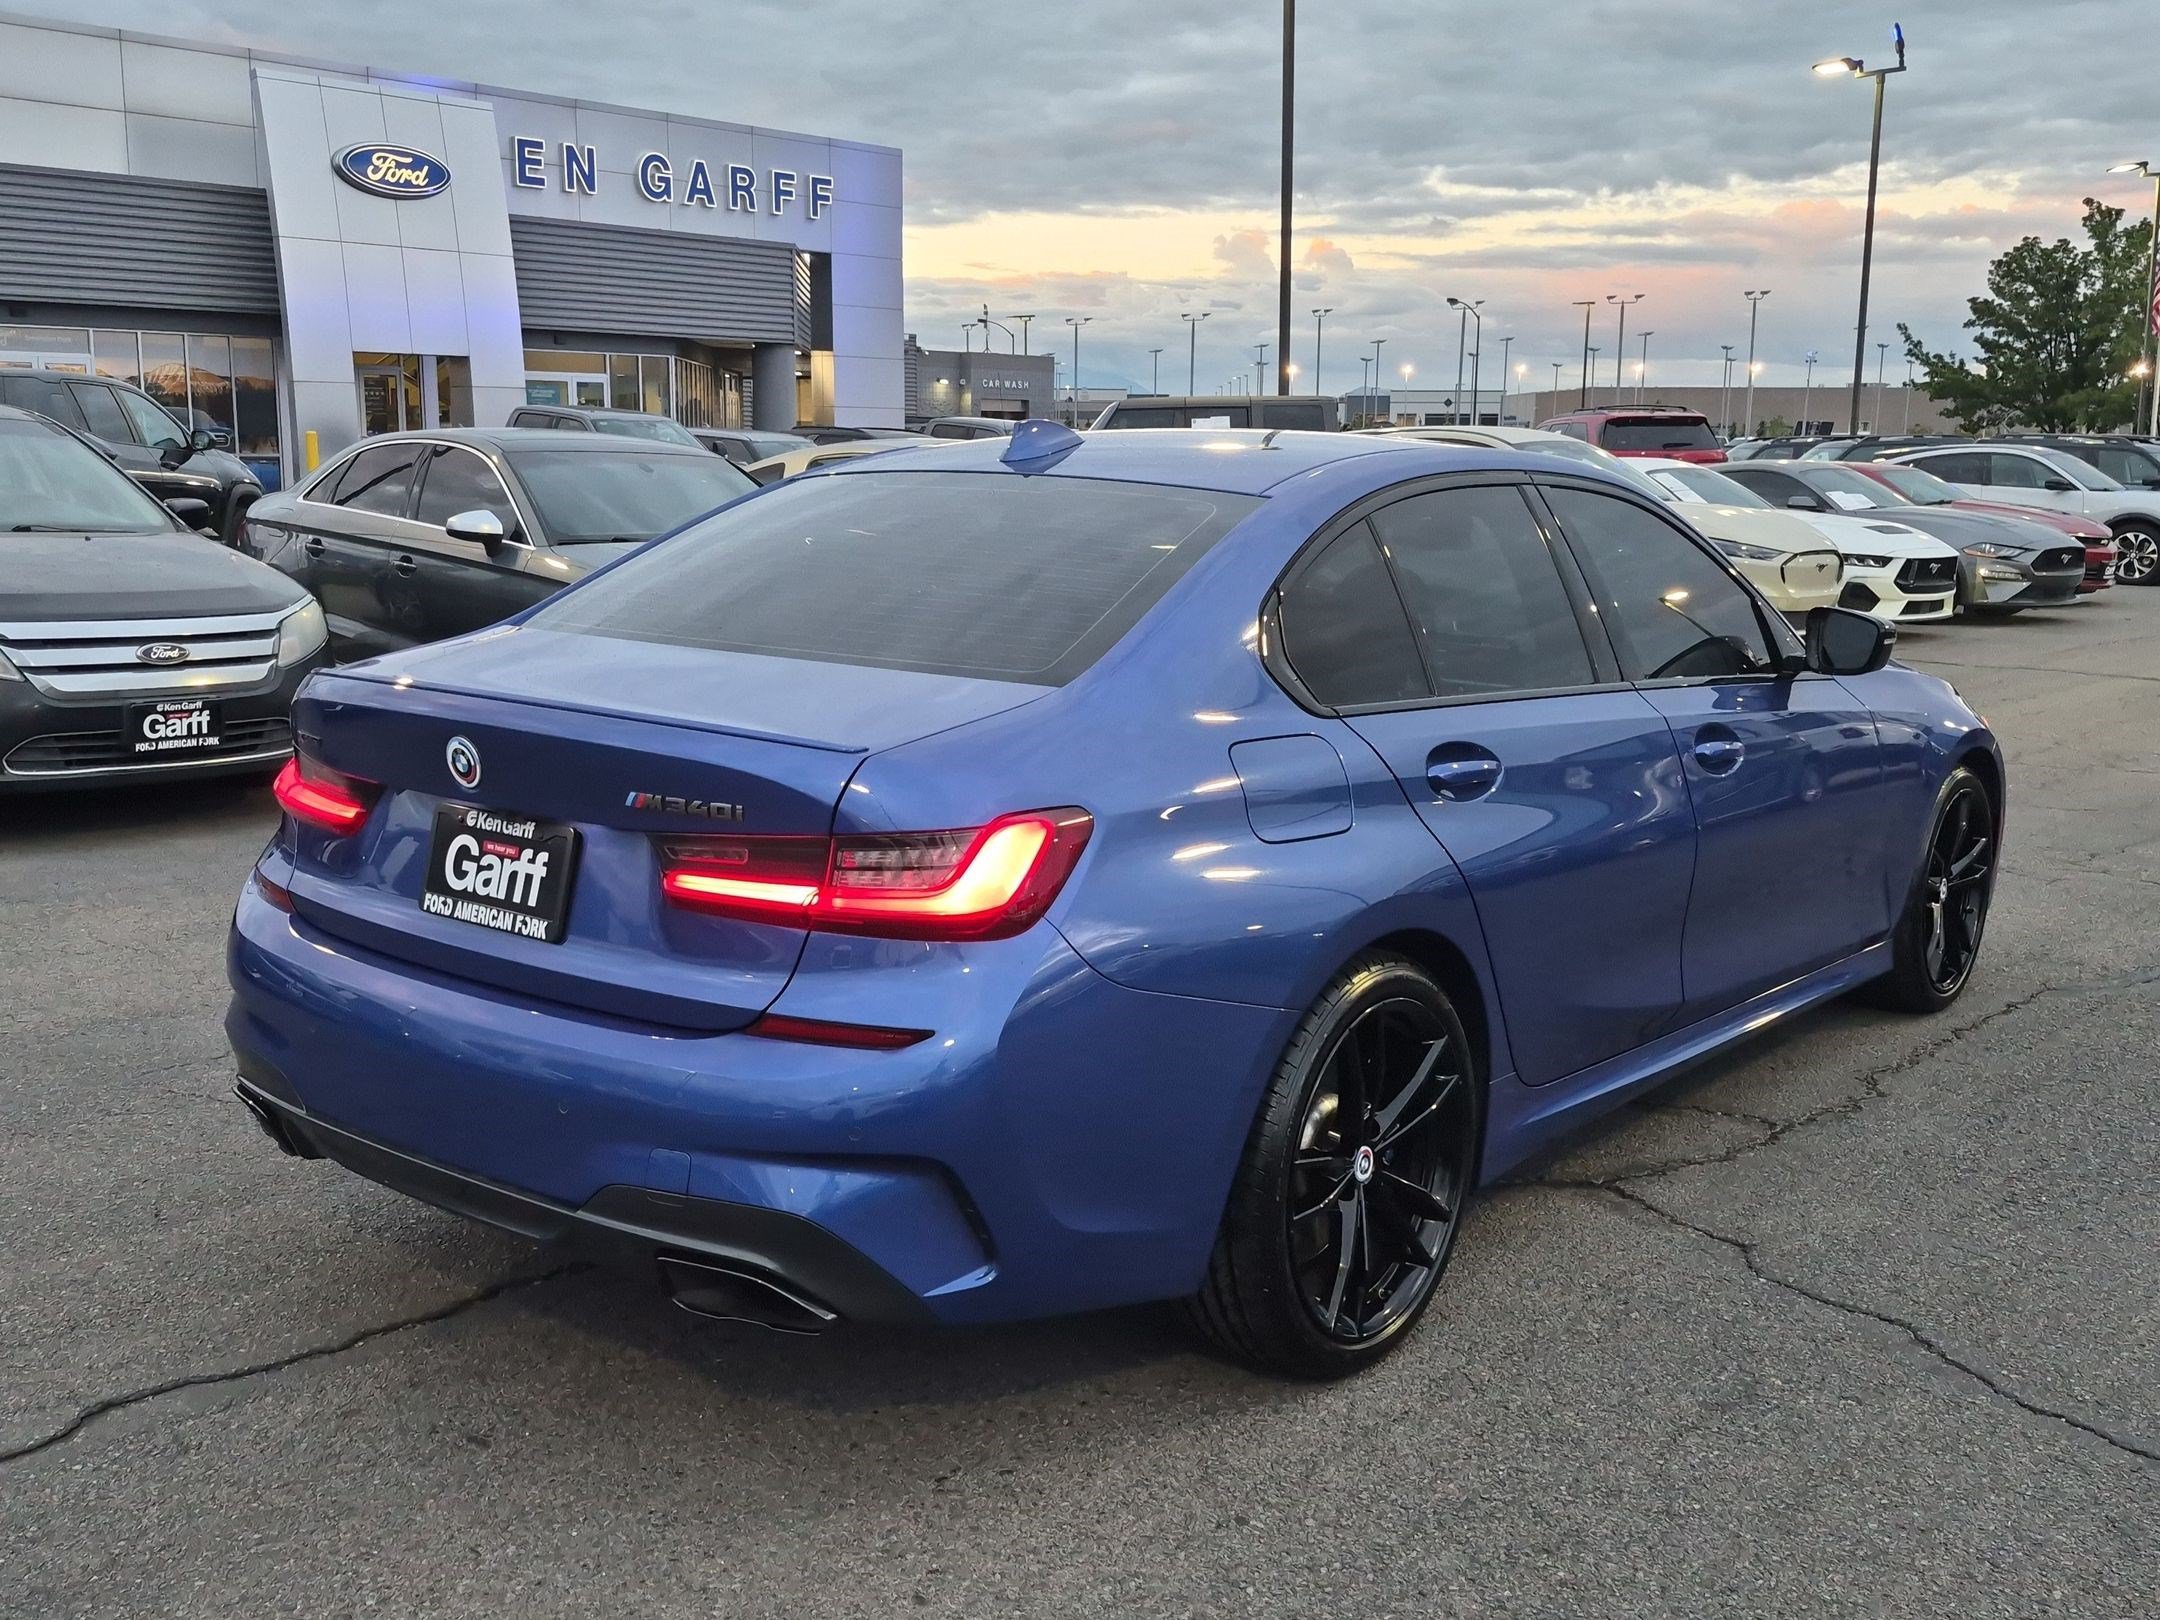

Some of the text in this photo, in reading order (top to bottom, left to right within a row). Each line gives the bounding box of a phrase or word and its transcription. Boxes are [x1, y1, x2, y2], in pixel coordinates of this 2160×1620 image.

[367, 152, 429, 186] Ford
[513, 136, 834, 219] EN GARFF
[982, 379, 1029, 389] CAR WASH
[150, 646, 179, 659] Ford
[164, 701, 203, 711] Ken Garff
[143, 709, 211, 739] Garff
[157, 738, 197, 750] AMERICAN
[198, 737, 220, 746] FORK
[641, 793, 744, 823] M340i
[476, 811, 536, 839] Ken Garff
[494, 843, 506, 852] hear
[506, 847, 516, 855] you
[444, 833, 550, 907] Garff
[423, 892, 548, 940] FORD AMERICAN FORK
